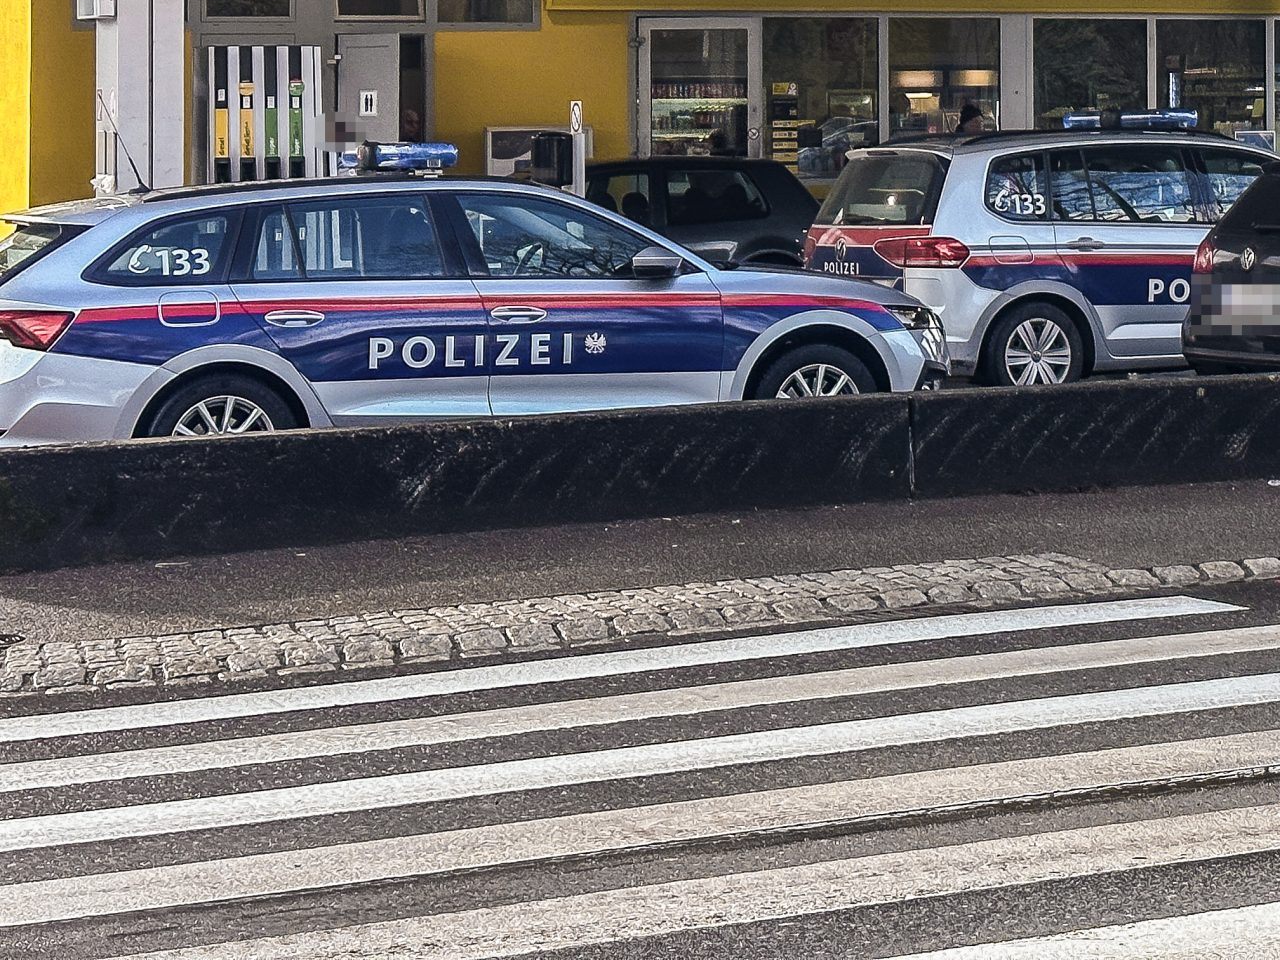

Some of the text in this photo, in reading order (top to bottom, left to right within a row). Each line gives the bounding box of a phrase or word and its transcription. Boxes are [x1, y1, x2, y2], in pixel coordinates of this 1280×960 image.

[1011, 193, 1046, 215] 133
[155, 248, 210, 276] 133
[823, 261, 859, 275] POLIZEI
[1148, 278, 1191, 303] PO
[368, 333, 573, 370] POLIZEI
